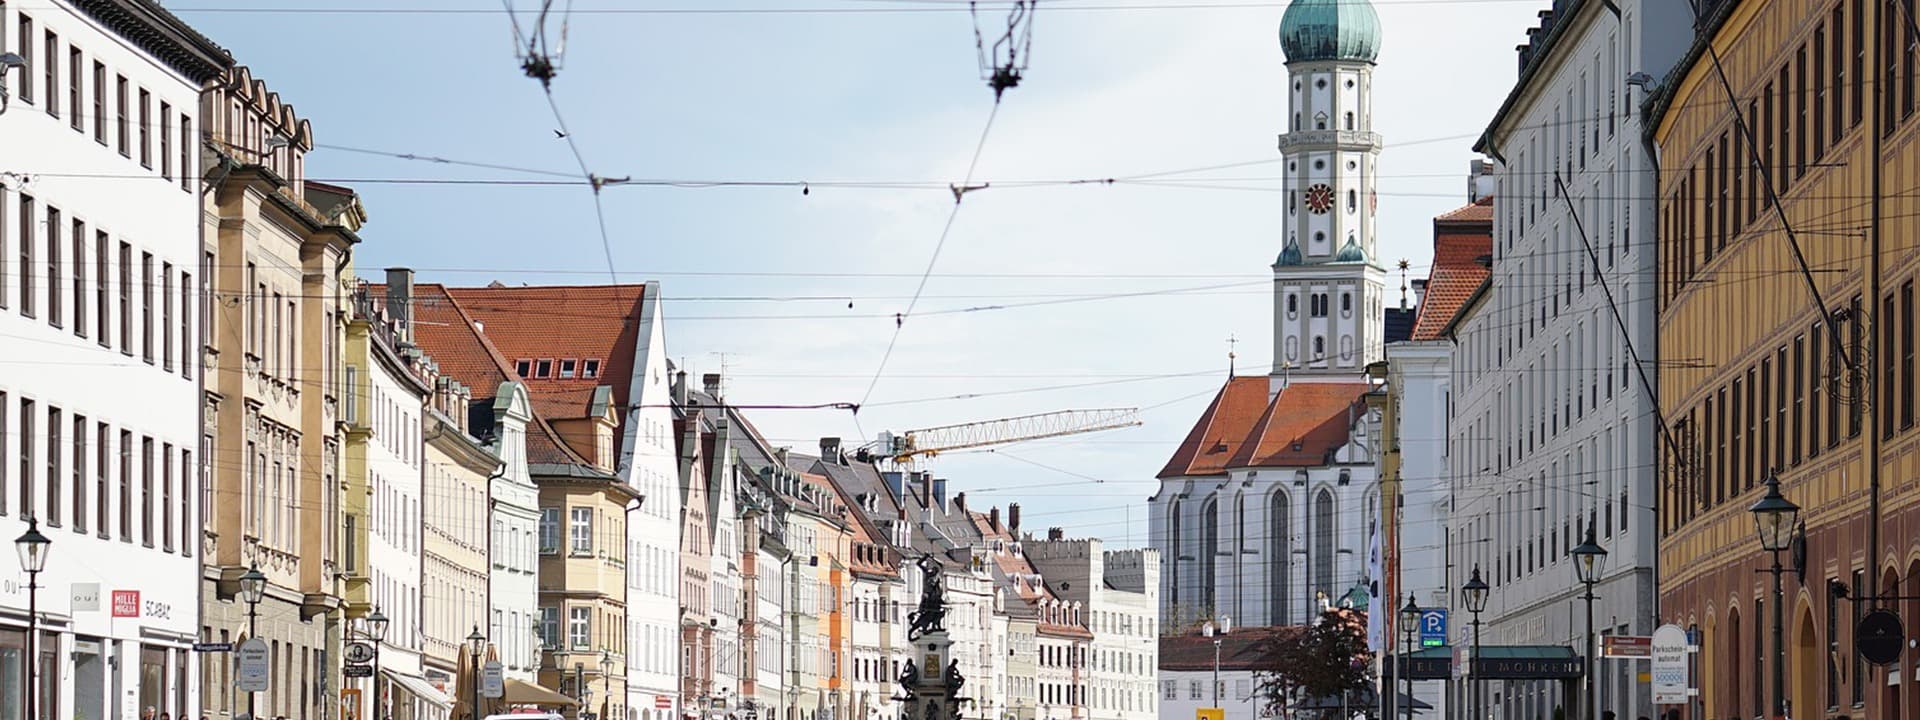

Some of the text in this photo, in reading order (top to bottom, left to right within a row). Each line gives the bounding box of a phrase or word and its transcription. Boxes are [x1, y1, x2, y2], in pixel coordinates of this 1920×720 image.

[74, 591, 98, 602] oui
[115, 593, 137, 604] MILLE
[115, 604, 137, 616] MIGLIA
[1658, 654, 1681, 662] automat
